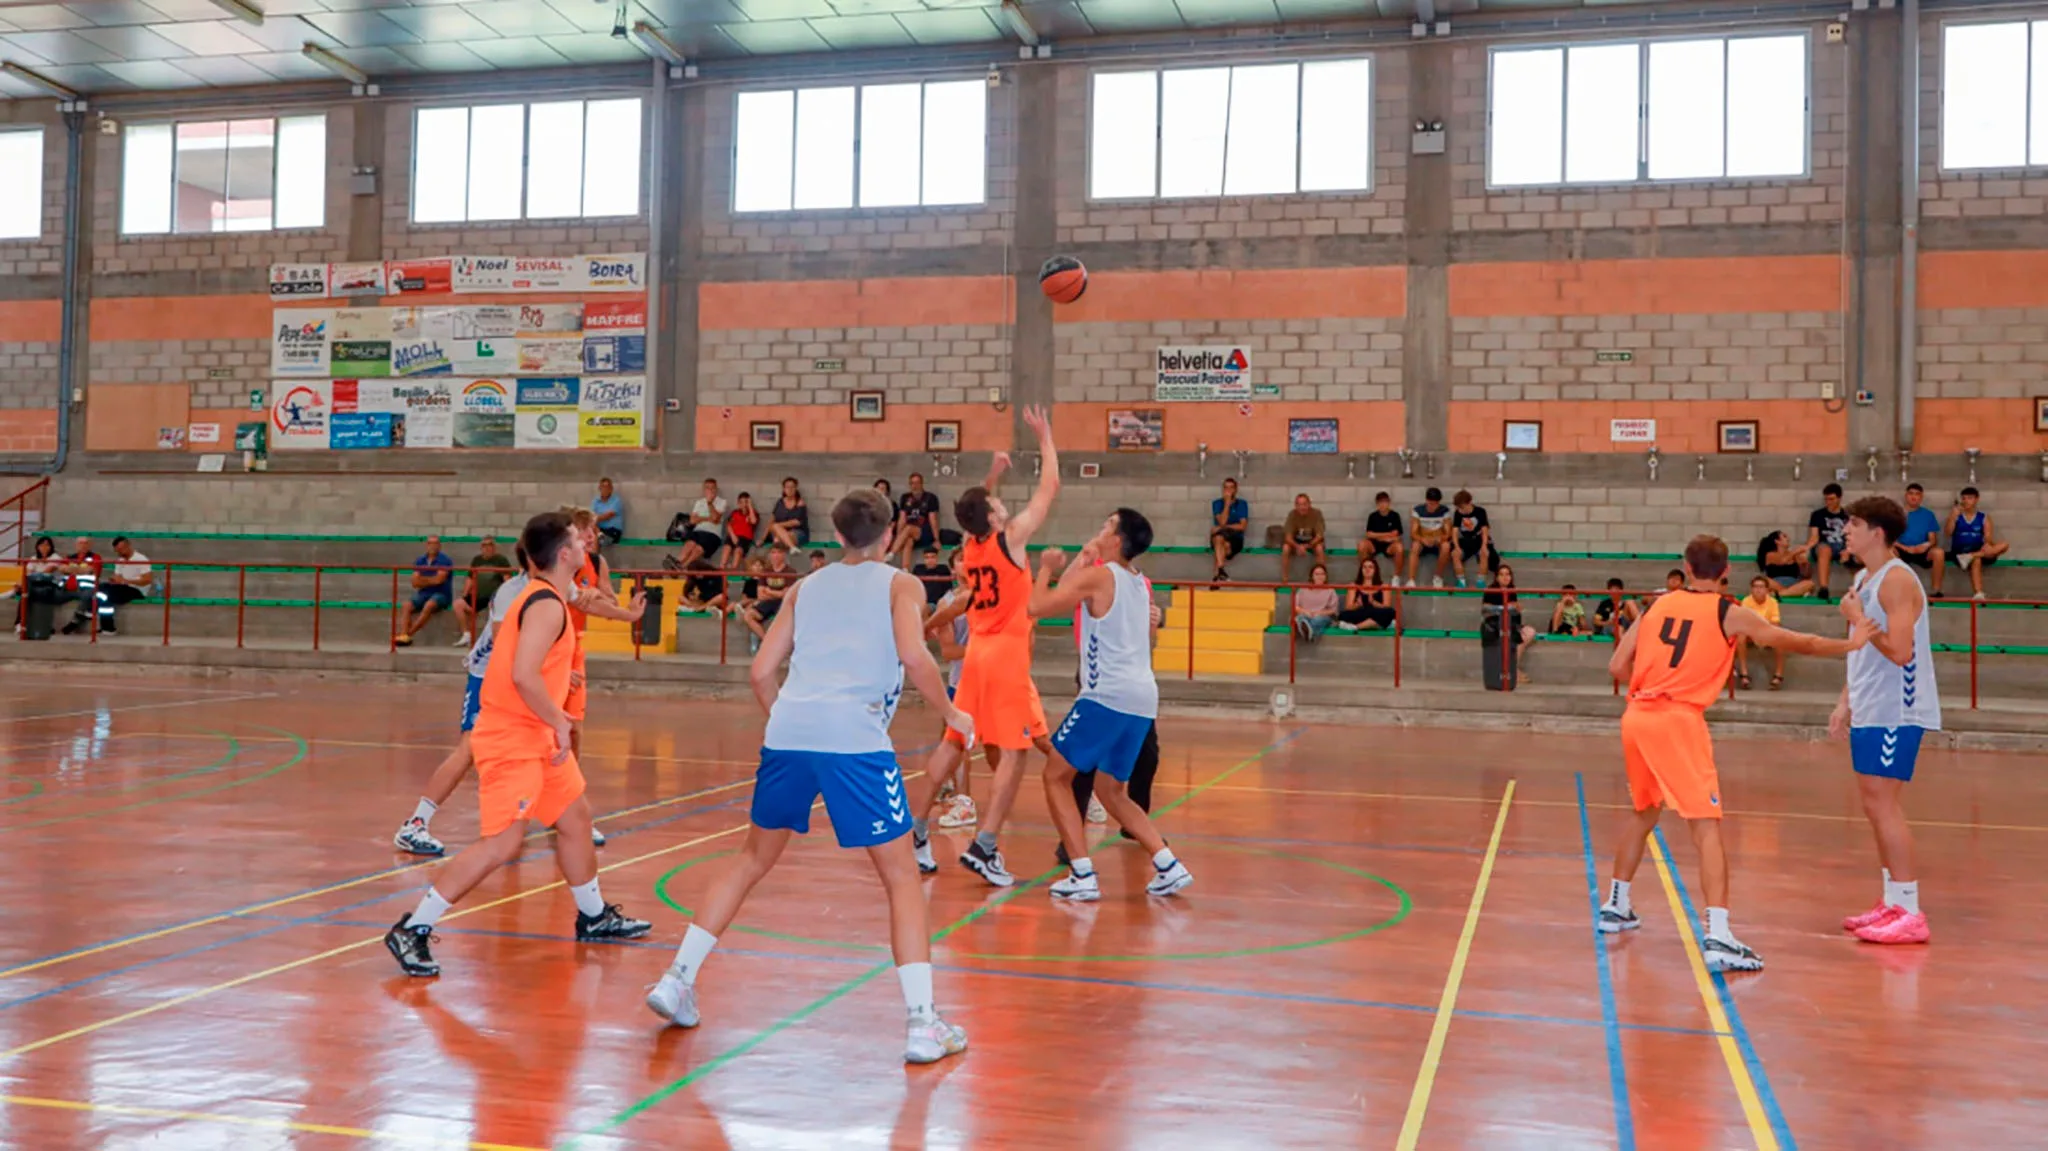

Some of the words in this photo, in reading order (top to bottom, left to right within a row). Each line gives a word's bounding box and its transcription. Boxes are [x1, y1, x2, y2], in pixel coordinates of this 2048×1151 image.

[475, 259, 509, 271] Noel
[515, 260, 564, 272] SEVISAL
[289, 269, 321, 281] BAR
[585, 312, 643, 326] MAPFRE
[1158, 349, 1223, 370] helvetia
[1158, 372, 1199, 385] Pascual
[967, 565, 1000, 610] 23
[1658, 616, 1694, 669] 4
